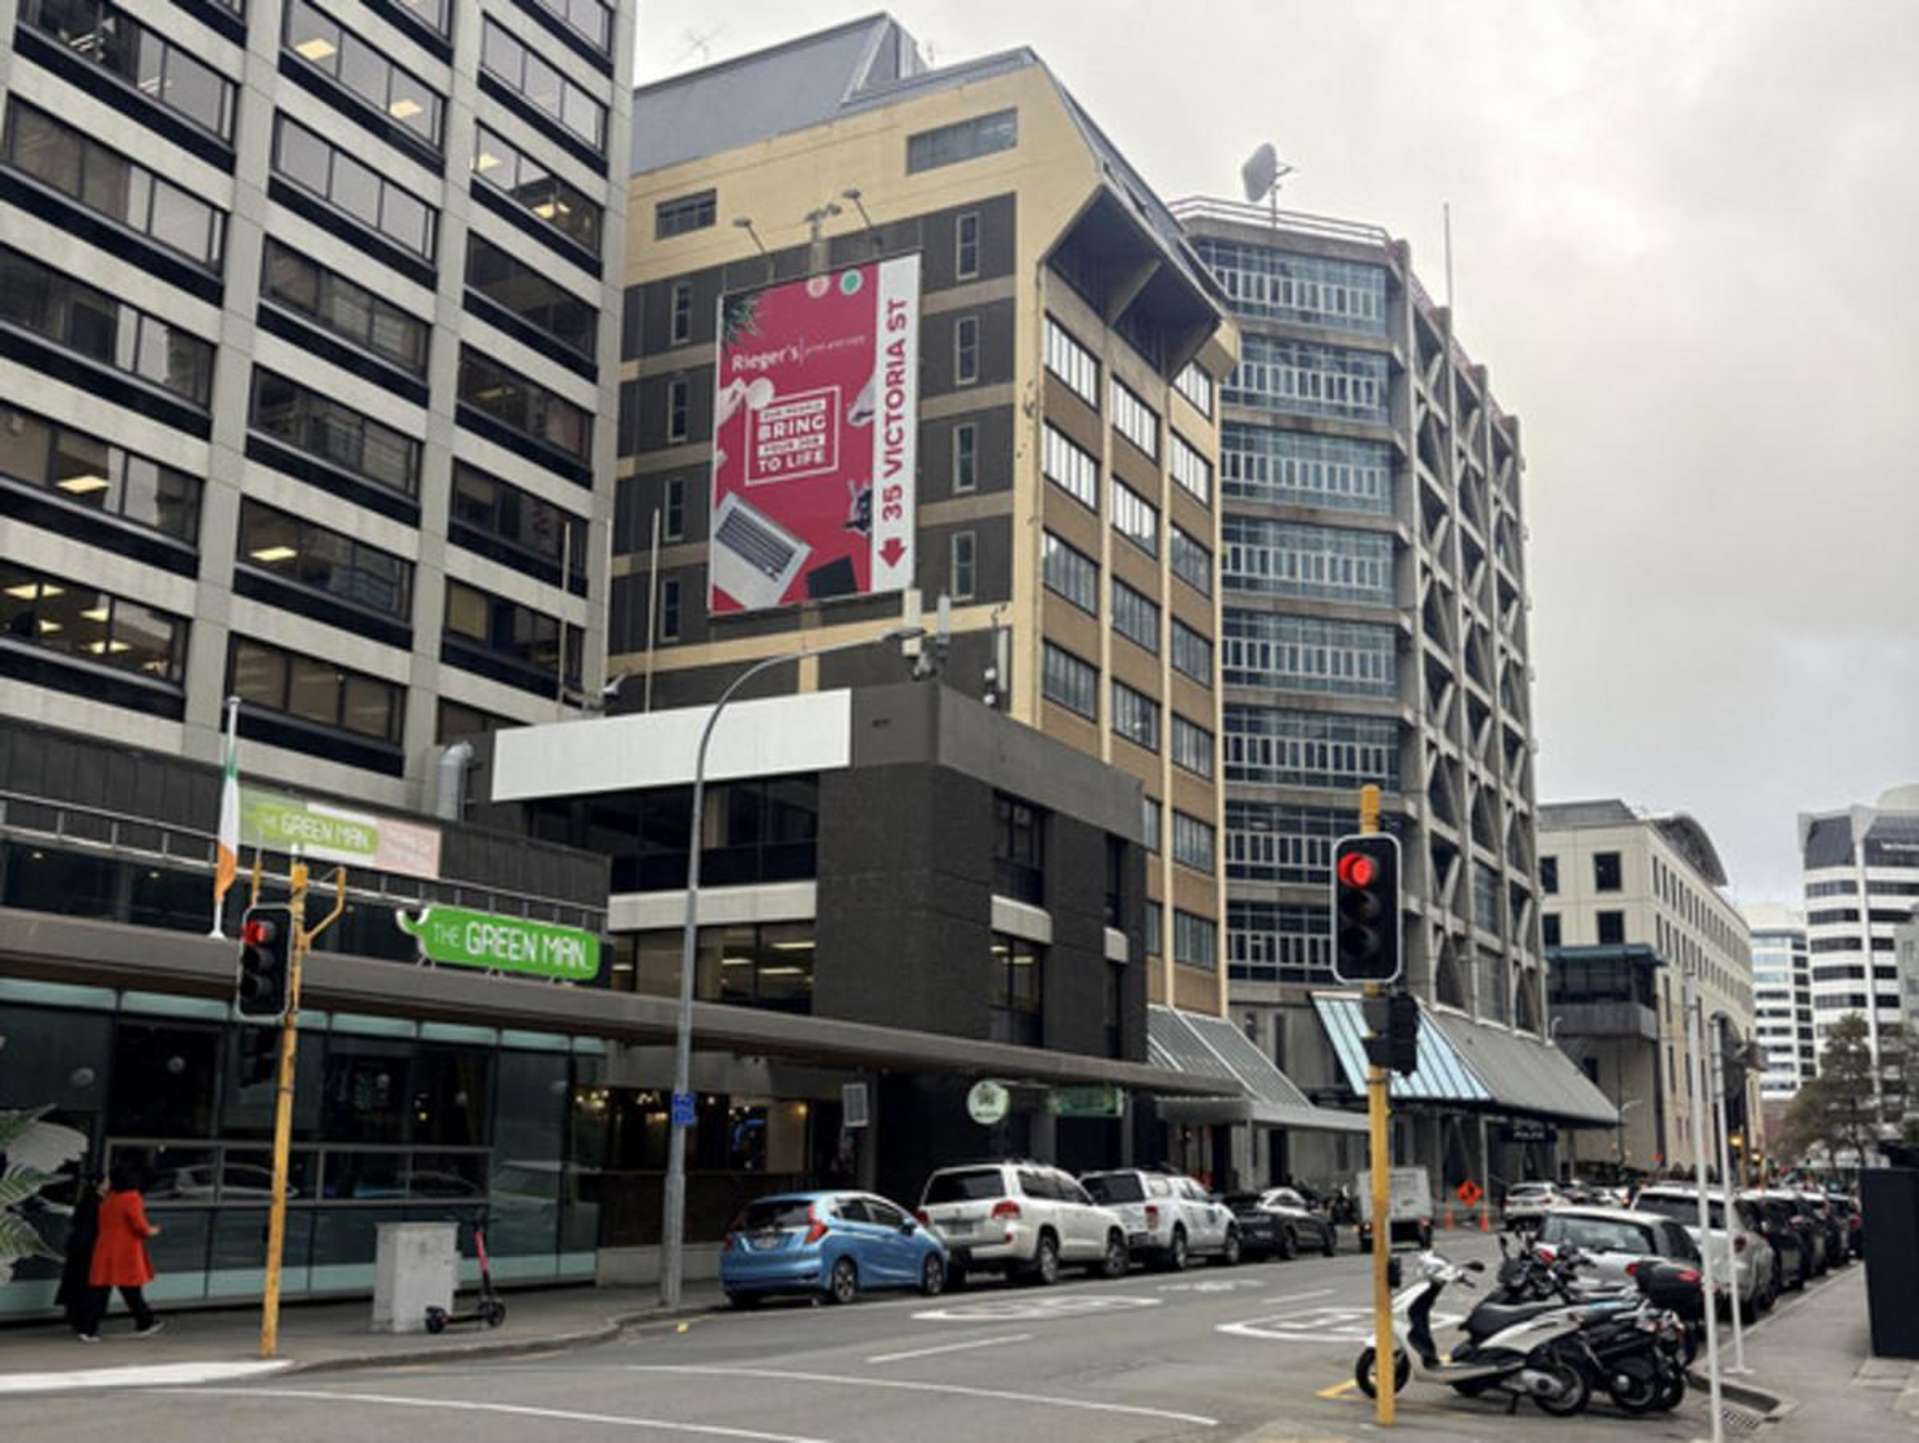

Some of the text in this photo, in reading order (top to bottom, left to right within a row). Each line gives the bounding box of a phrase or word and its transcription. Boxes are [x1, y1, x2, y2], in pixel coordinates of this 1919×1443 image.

[731, 344, 798, 372] Rieger's
[882, 298, 908, 523] 35 VICTORIA ST
[758, 415, 826, 441] BRING
[758, 449, 824, 472] TO LIFE
[281, 813, 333, 844] GREEN
[336, 824, 368, 850] MAN
[433, 921, 588, 969] THE GREEN MAN
